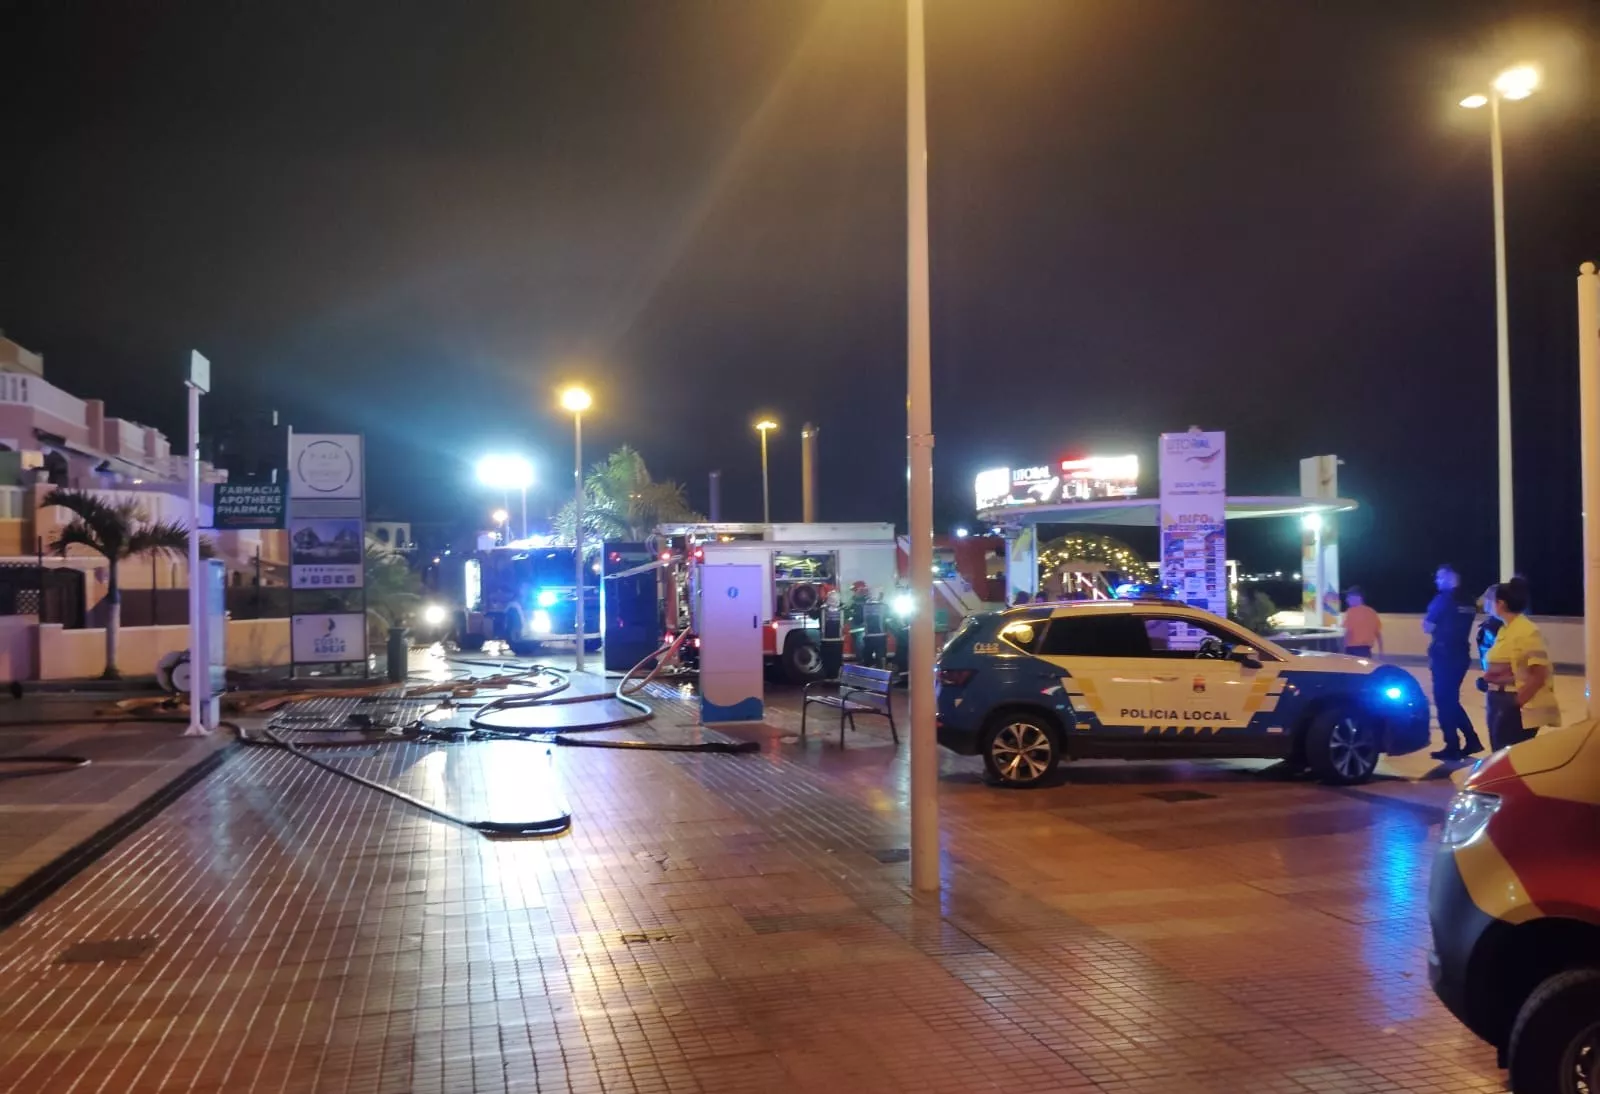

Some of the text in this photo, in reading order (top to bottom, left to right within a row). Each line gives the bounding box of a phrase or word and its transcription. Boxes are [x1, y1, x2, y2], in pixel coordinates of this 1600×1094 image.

[219, 485, 281, 495] FARMACIA
[219, 495, 281, 505] APOTHEKE
[217, 505, 282, 514] PHARMACY
[1120, 708, 1231, 721] POLICIA LOCAL
